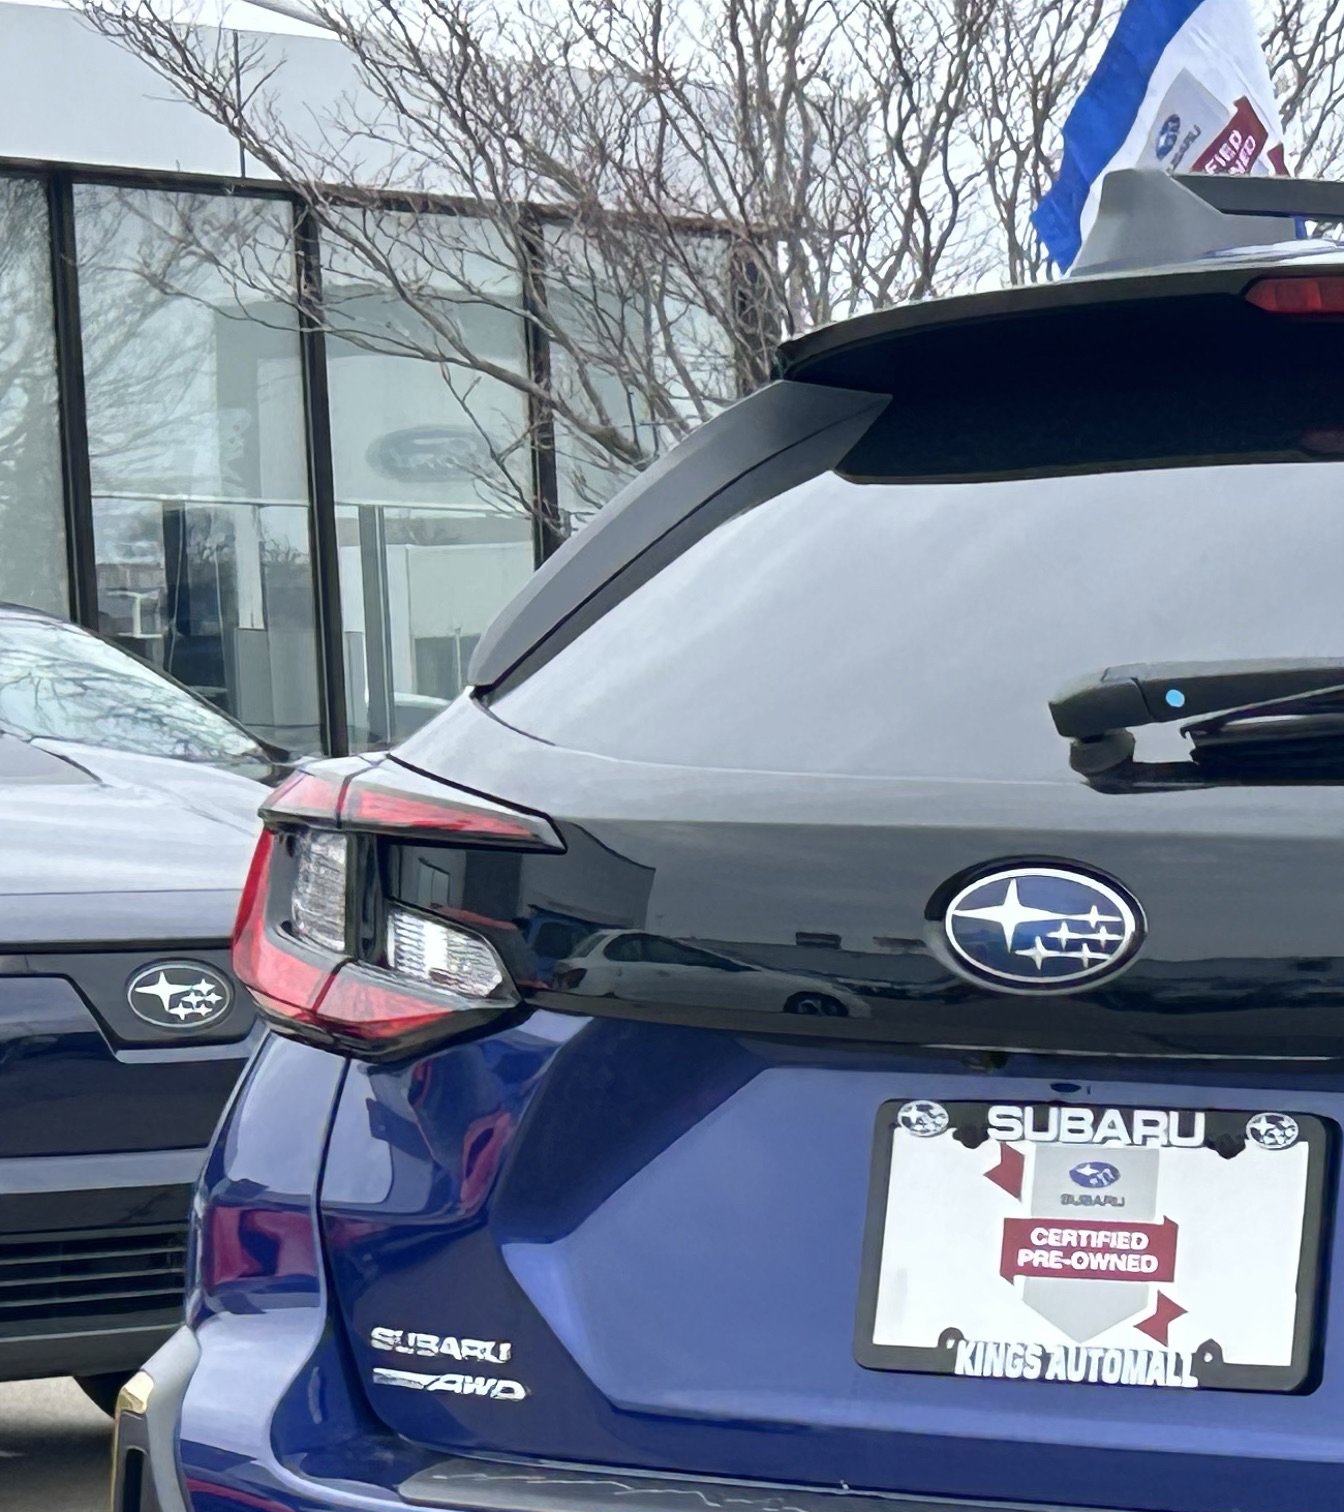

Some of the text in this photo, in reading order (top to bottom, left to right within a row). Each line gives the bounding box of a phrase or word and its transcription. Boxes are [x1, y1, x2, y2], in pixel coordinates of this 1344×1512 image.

[988, 1105, 1206, 1148] SUBARU
[1060, 1194, 1126, 1207] SUBARU
[1030, 1227, 1149, 1251] CERTIFIED
[1017, 1250, 1159, 1274] PRE-OWNED
[370, 1326, 512, 1363] SUBARU
[954, 1340, 1199, 1388] KINGS AUTOMALL
[427, 1373, 529, 1402] AWD
